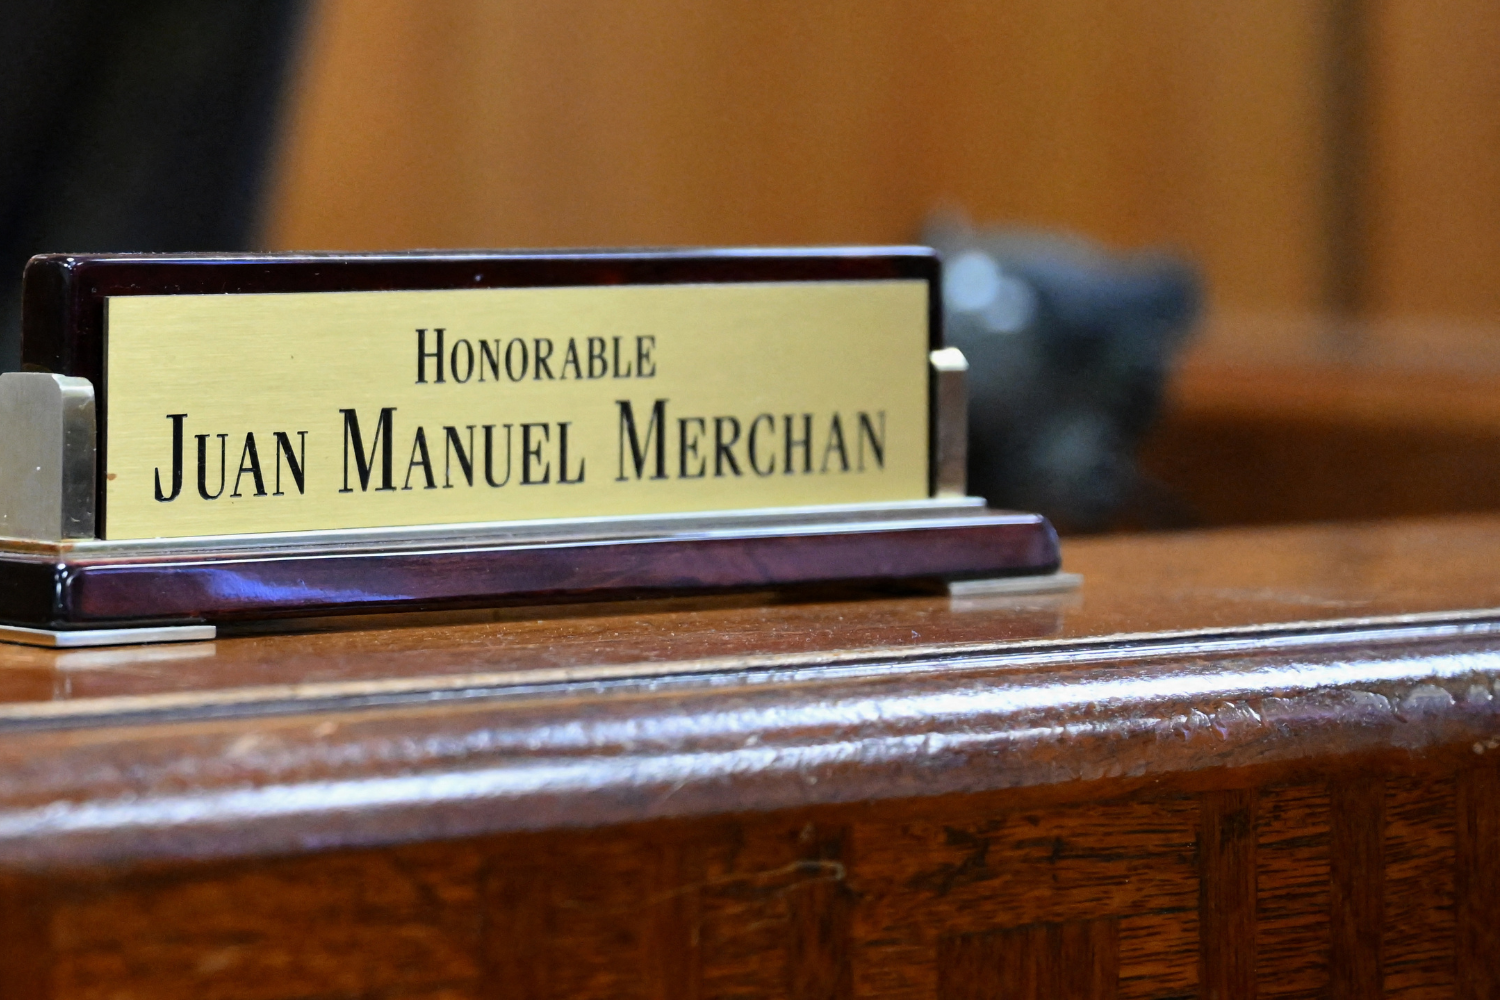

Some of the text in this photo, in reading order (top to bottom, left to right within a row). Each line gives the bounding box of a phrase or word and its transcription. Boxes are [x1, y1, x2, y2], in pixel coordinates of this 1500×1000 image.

[415, 328, 656, 384] HONORABLE
[154, 397, 886, 502] JUAN MANUEL MERCHAN
